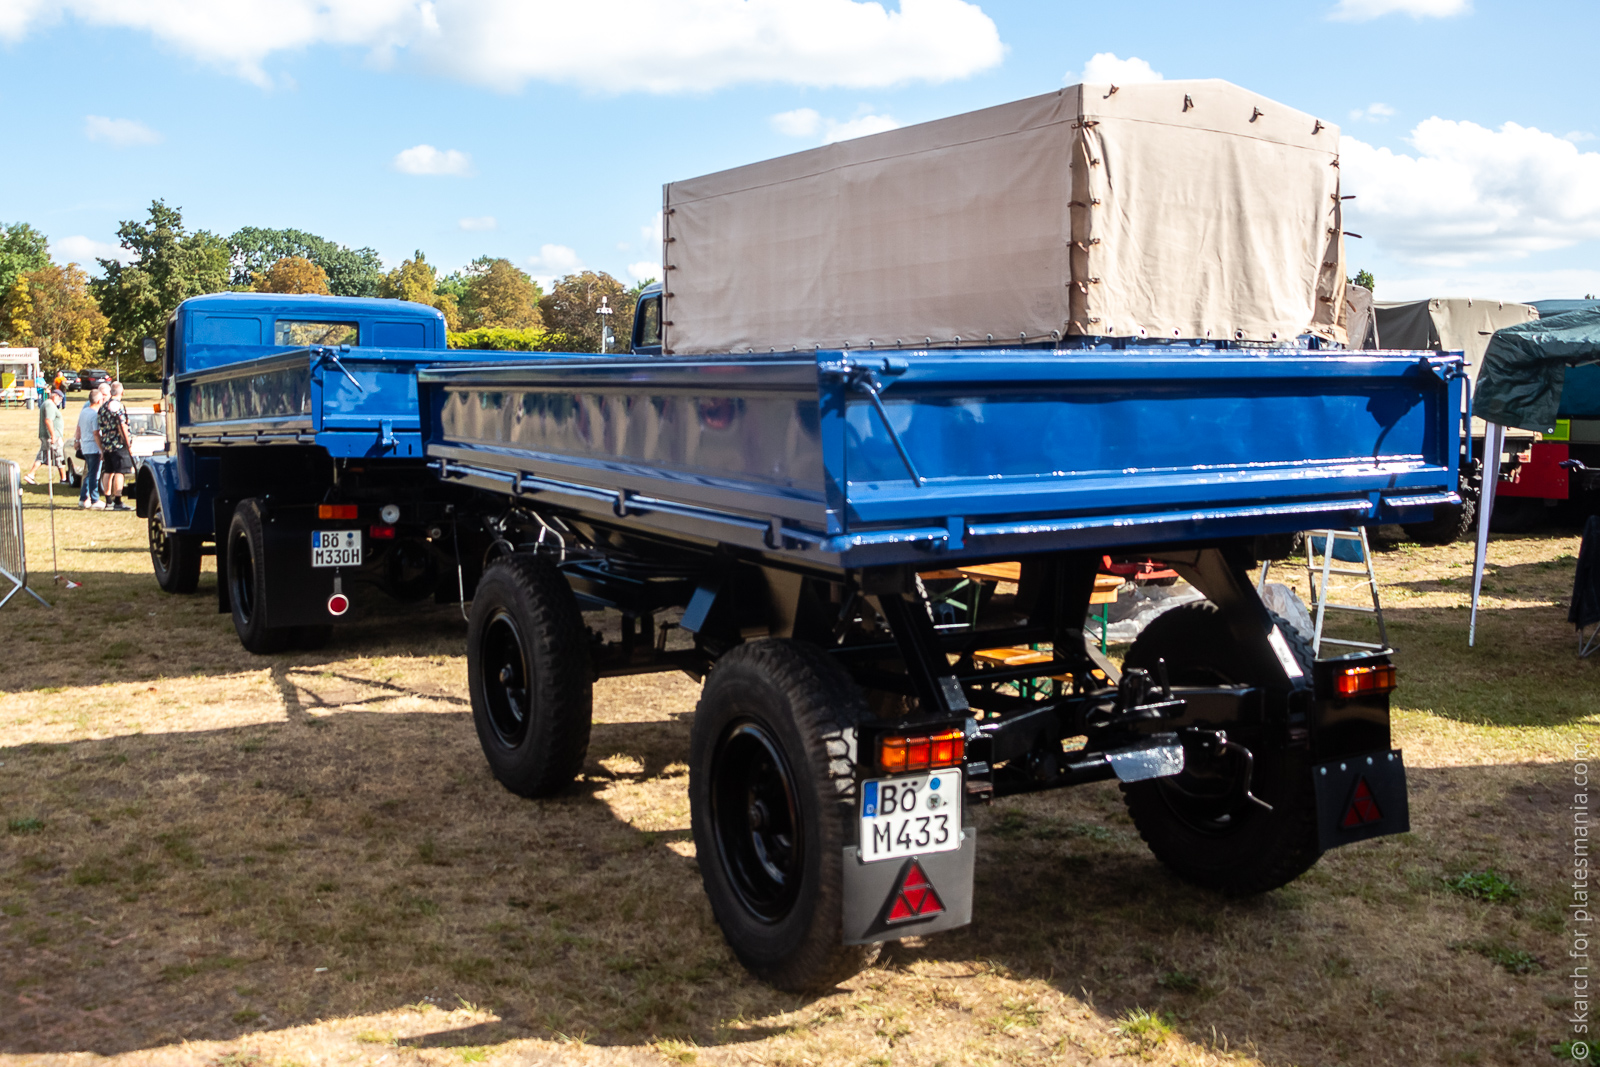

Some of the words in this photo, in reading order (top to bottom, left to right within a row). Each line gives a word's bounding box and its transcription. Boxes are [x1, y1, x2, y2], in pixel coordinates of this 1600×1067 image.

[322, 533, 339, 548] BÖ
[315, 549, 360, 565] M330H
[879, 780, 918, 815] BÖ
[873, 814, 949, 854] M433
